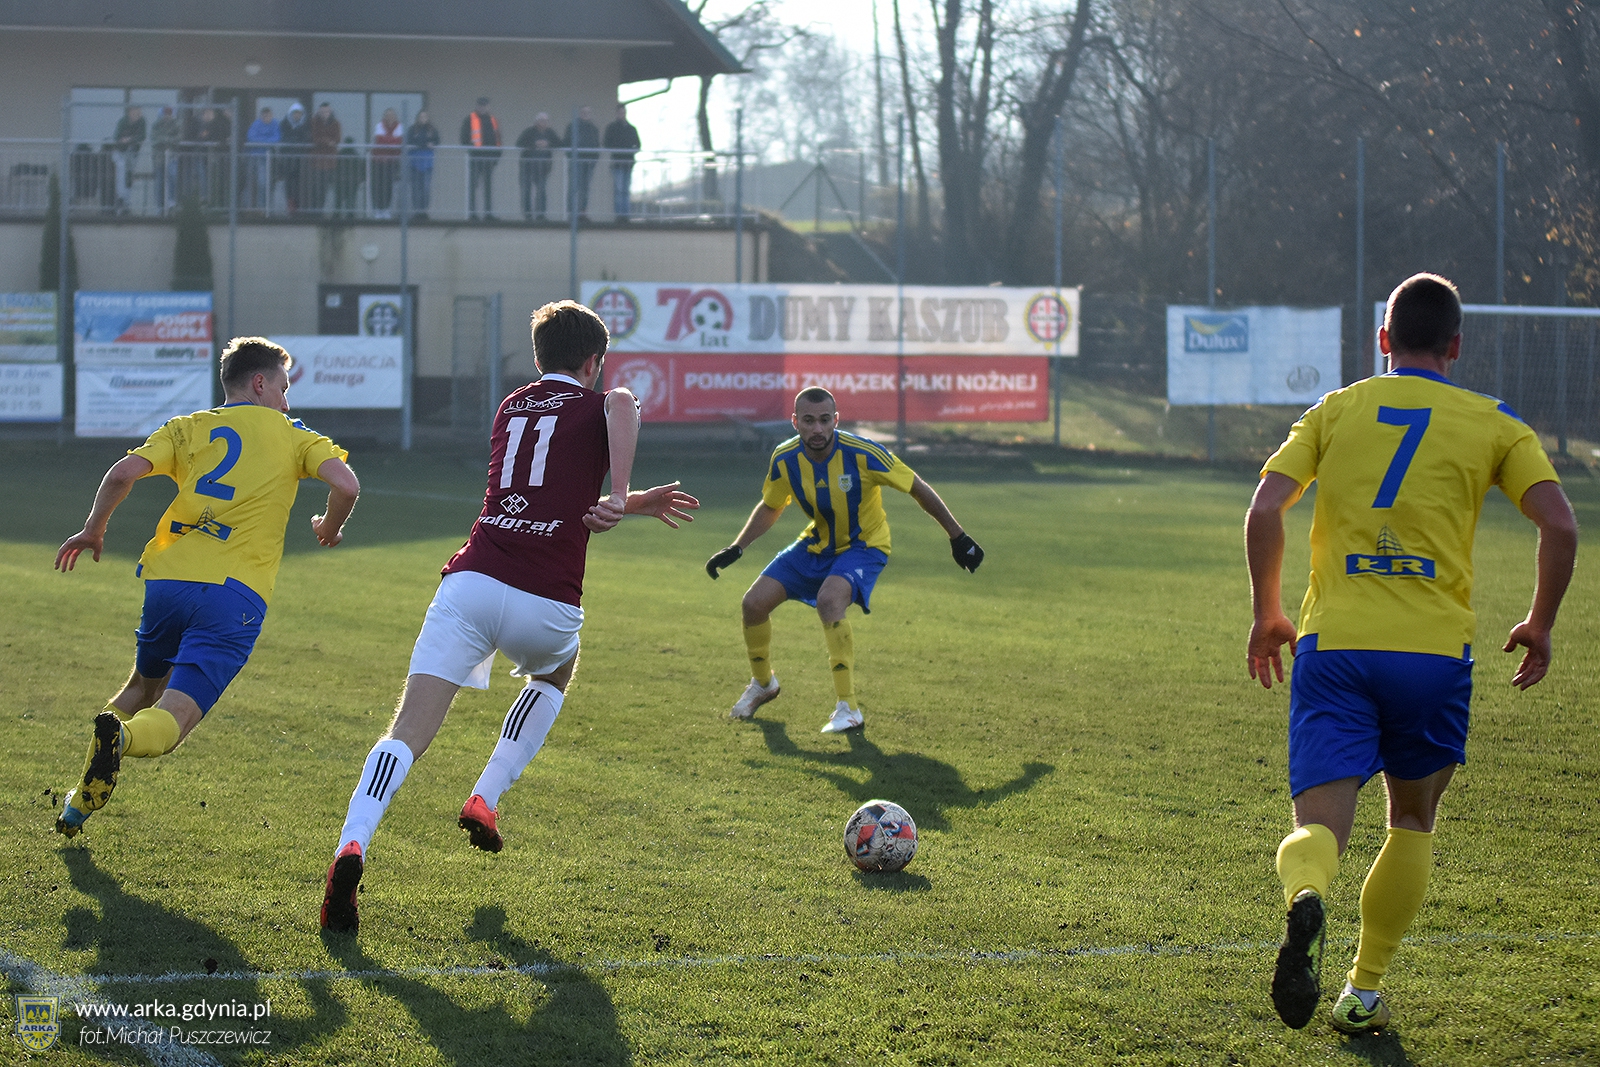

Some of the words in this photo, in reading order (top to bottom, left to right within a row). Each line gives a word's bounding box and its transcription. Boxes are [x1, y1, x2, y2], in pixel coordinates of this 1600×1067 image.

[748, 295, 854, 342] DUMY
[867, 297, 1010, 343] KASZUB
[701, 331, 729, 347] lat
[1189, 331, 1239, 349] Dulux
[312, 355, 397, 368] FUNDACJA
[313, 370, 364, 387] Energa
[684, 372, 797, 390] POMORSKI
[801, 373, 895, 394] ZWIĄZEK
[901, 374, 950, 391] PIŁKI
[956, 371, 1038, 392] NOŻNEJ
[194, 425, 243, 501] 2
[499, 415, 559, 490] 11
[1371, 405, 1433, 508] 7
[479, 513, 564, 533] olgraf
